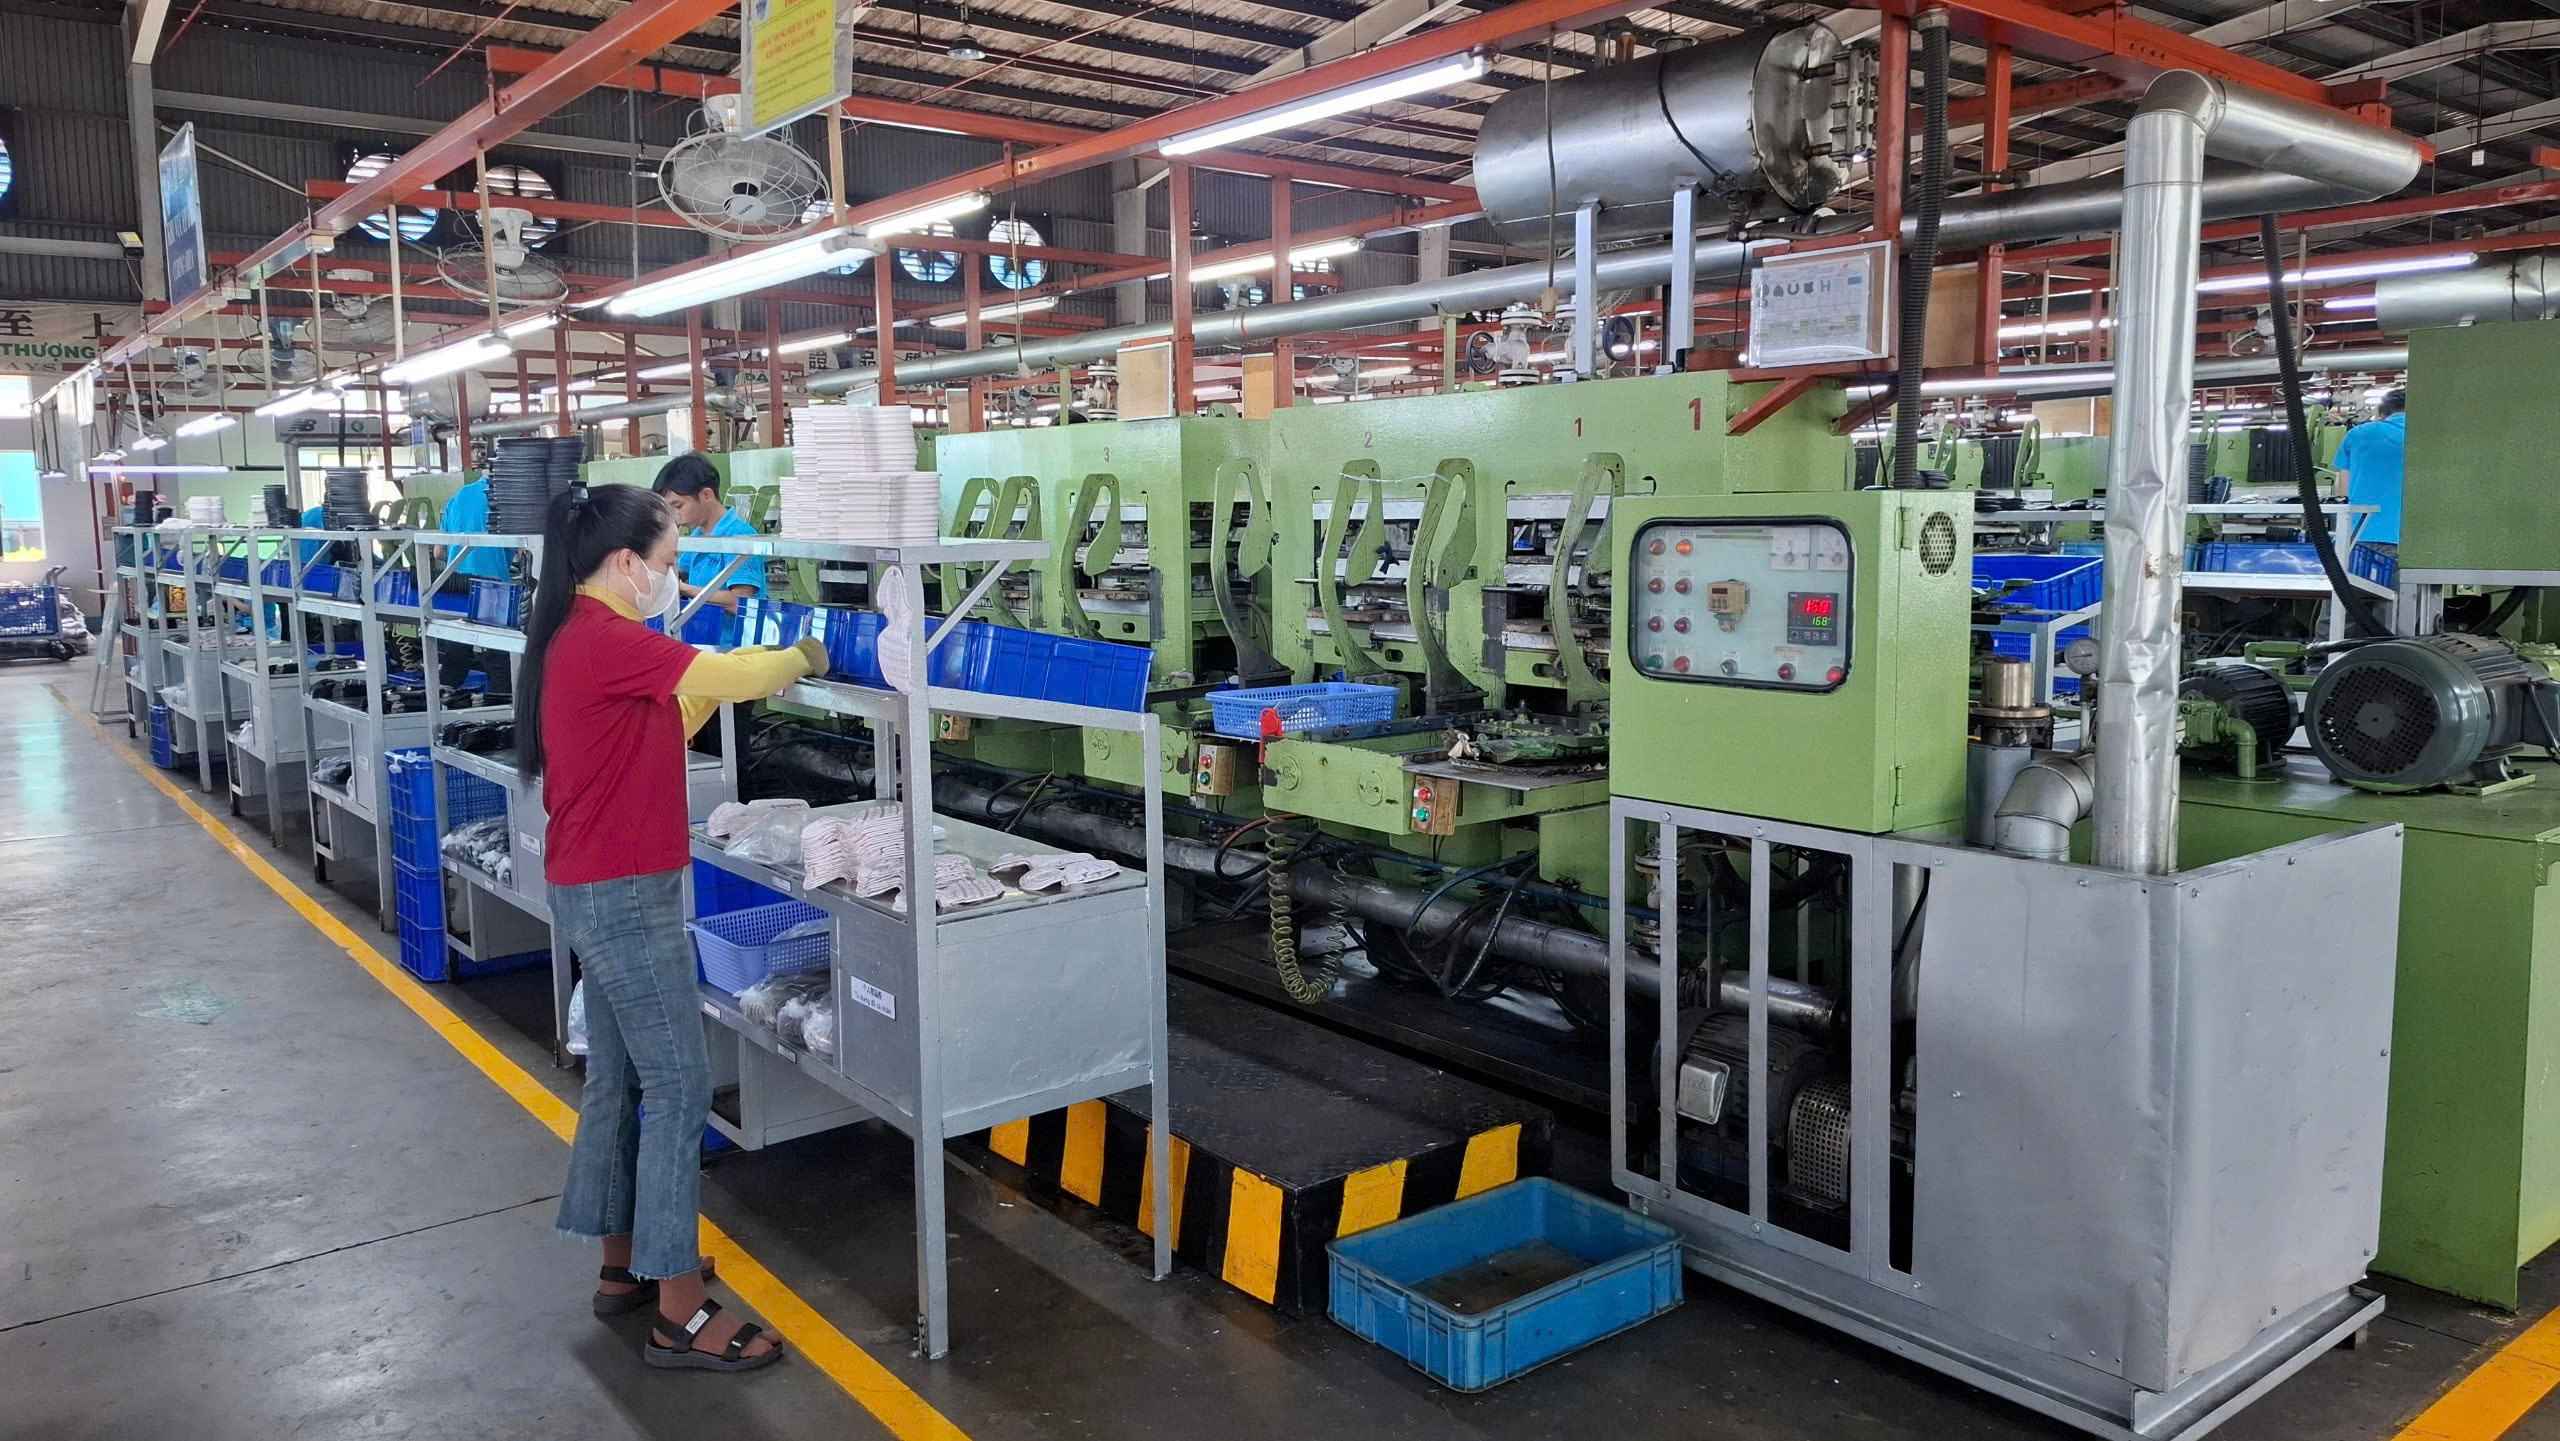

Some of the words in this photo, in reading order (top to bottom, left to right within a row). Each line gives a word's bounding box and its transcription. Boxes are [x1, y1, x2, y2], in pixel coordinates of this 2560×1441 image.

[1689, 397, 1702, 431] 1
[1574, 417, 1583, 437] 1
[1363, 431, 1373, 448] 2
[2227, 439, 2235, 450] 2
[1103, 447, 1110, 462] 3
[1812, 616, 1828, 626] 168
